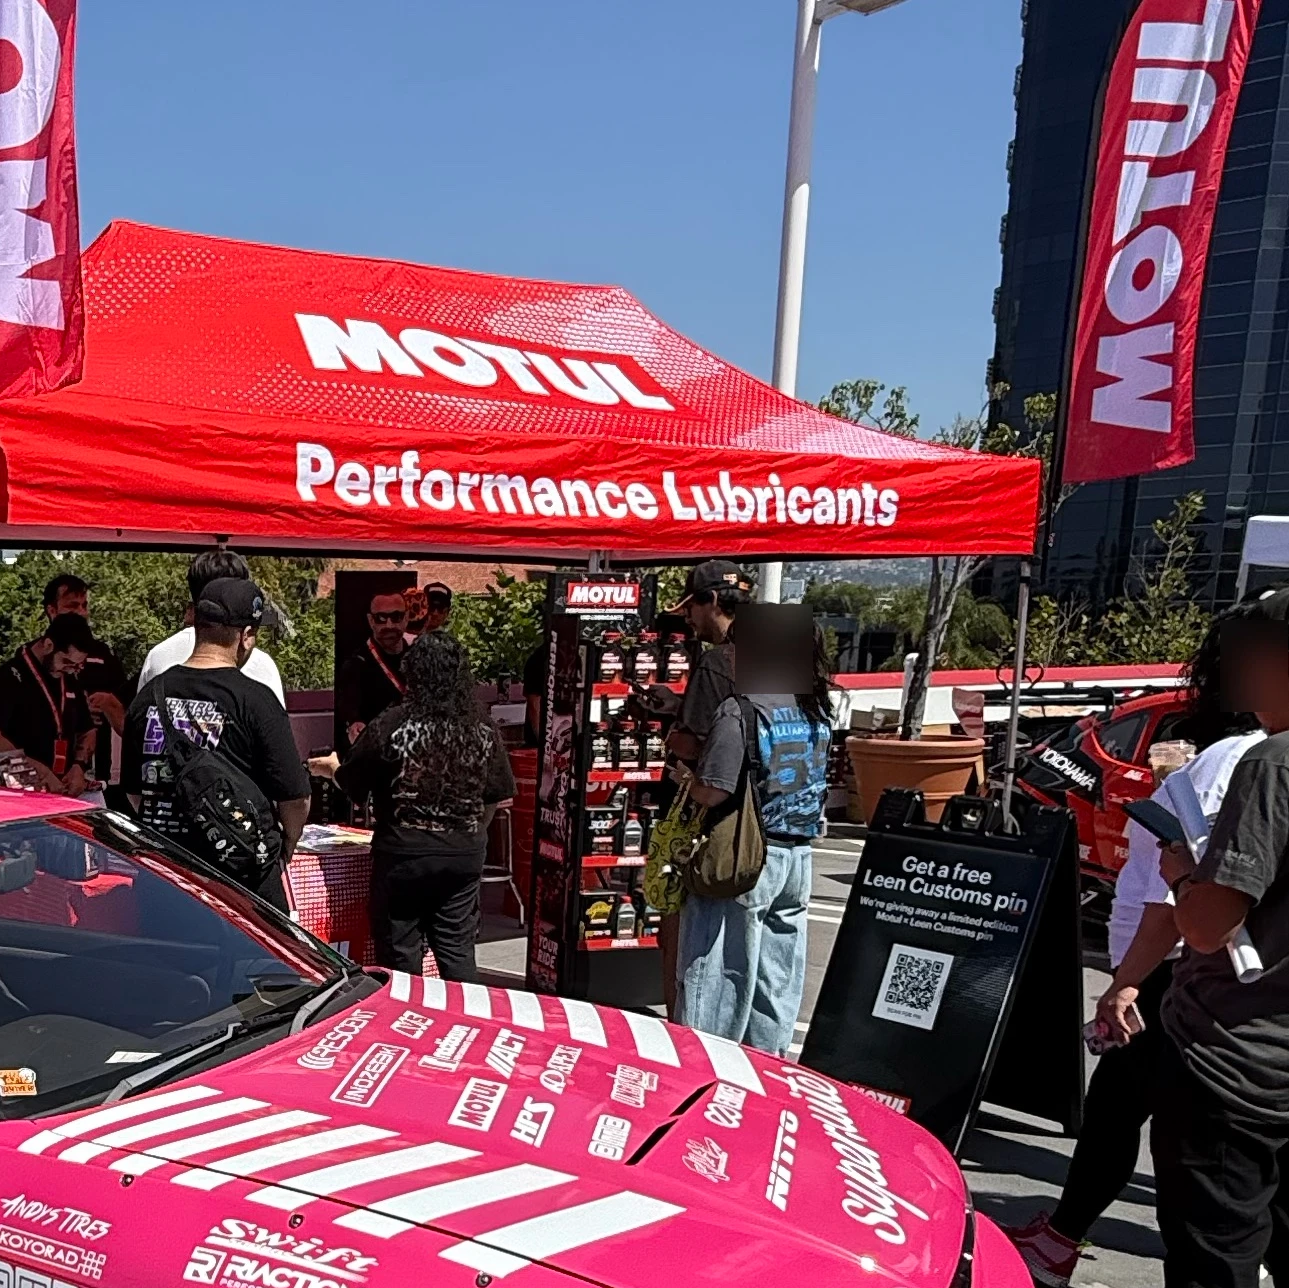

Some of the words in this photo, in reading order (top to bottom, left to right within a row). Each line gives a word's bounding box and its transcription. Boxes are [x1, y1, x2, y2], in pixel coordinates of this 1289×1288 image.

[1090, 0, 1237, 434] MOTUL
[294, 311, 676, 412] MOTUL
[295, 441, 659, 521] Performance
[662, 470, 900, 528] Lubricants
[571, 585, 636, 604] MOTUL
[1038, 746, 1099, 792] YOKOHAMA
[863, 869, 906, 891] Leen
[909, 877, 993, 906] Customs
[993, 892, 1028, 913] pin
[902, 856, 936, 876] Get
[937, 865, 950, 879] a
[952, 863, 992, 886] free
[860, 896, 885, 910] We're
[885, 899, 914, 915] giving
[915, 906, 940, 920] away
[941, 912, 948, 920] a
[948, 911, 983, 928] limited
[983, 919, 1019, 934] edition
[933, 921, 976, 939] Customs
[976, 931, 994, 941] pin
[456, 1081, 501, 1128] MOTUL
[509, 1095, 555, 1149] HPS
[851, 1085, 906, 1115] OTUL
[765, 1109, 800, 1212] NITTO
[0, 1193, 64, 1227] ANDYS
[58, 1207, 113, 1241] TIRES
